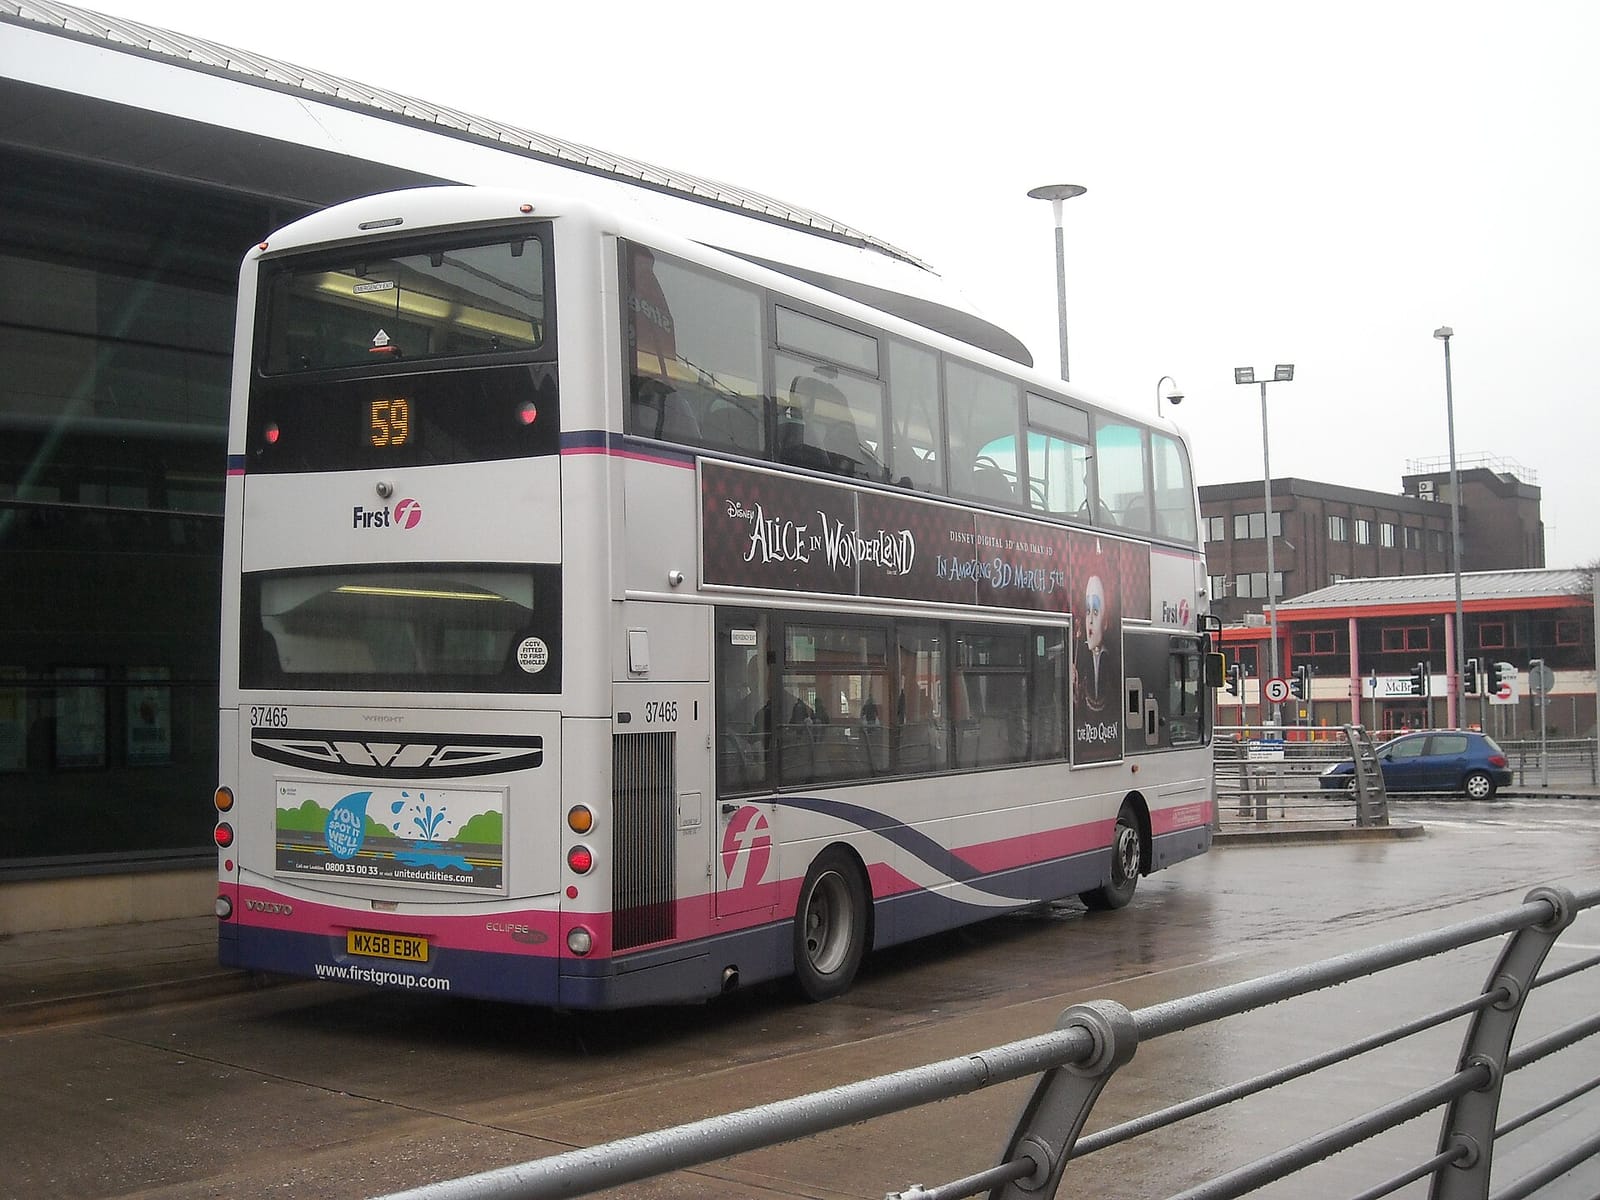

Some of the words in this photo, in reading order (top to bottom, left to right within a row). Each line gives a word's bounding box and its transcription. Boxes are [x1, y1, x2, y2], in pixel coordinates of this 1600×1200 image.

[371, 399, 408, 446] 59
[353, 506, 390, 528] First
[809, 536, 822, 551] IN
[950, 530, 974, 545] DISNEY
[977, 535, 1003, 548] DIGITAL
[1016, 542, 1028, 552] AND
[991, 558, 1012, 588] 3D
[1162, 600, 1178, 624] First
[1272, 684, 1281, 697] 5
[1385, 682, 1412, 692] McBr
[250, 706, 288, 727] 37465
[362, 714, 405, 723] WRIGHT
[645, 701, 678, 723] 37465
[1085, 722, 1098, 743] RED
[1098, 721, 1118, 743] QUEEN
[333, 807, 360, 828] YOU
[328, 829, 358, 848] WE'LL
[329, 820, 352, 834] SPOT
[352, 829, 361, 837] IT
[329, 840, 347, 855] STOP
[347, 847, 356, 855] IT
[325, 862, 345, 872] 0800
[346, 864, 355, 874] 33
[356, 865, 367, 874] 00
[368, 866, 378, 875] 33
[394, 869, 474, 883] unitedutilities.com
[245, 899, 293, 916] VOLVO
[486, 922, 529, 934] ECLIPSE
[354, 934, 389, 954] MX58
[394, 941, 421, 958] EBK
[315, 963, 450, 991] www.firstgroup.com
